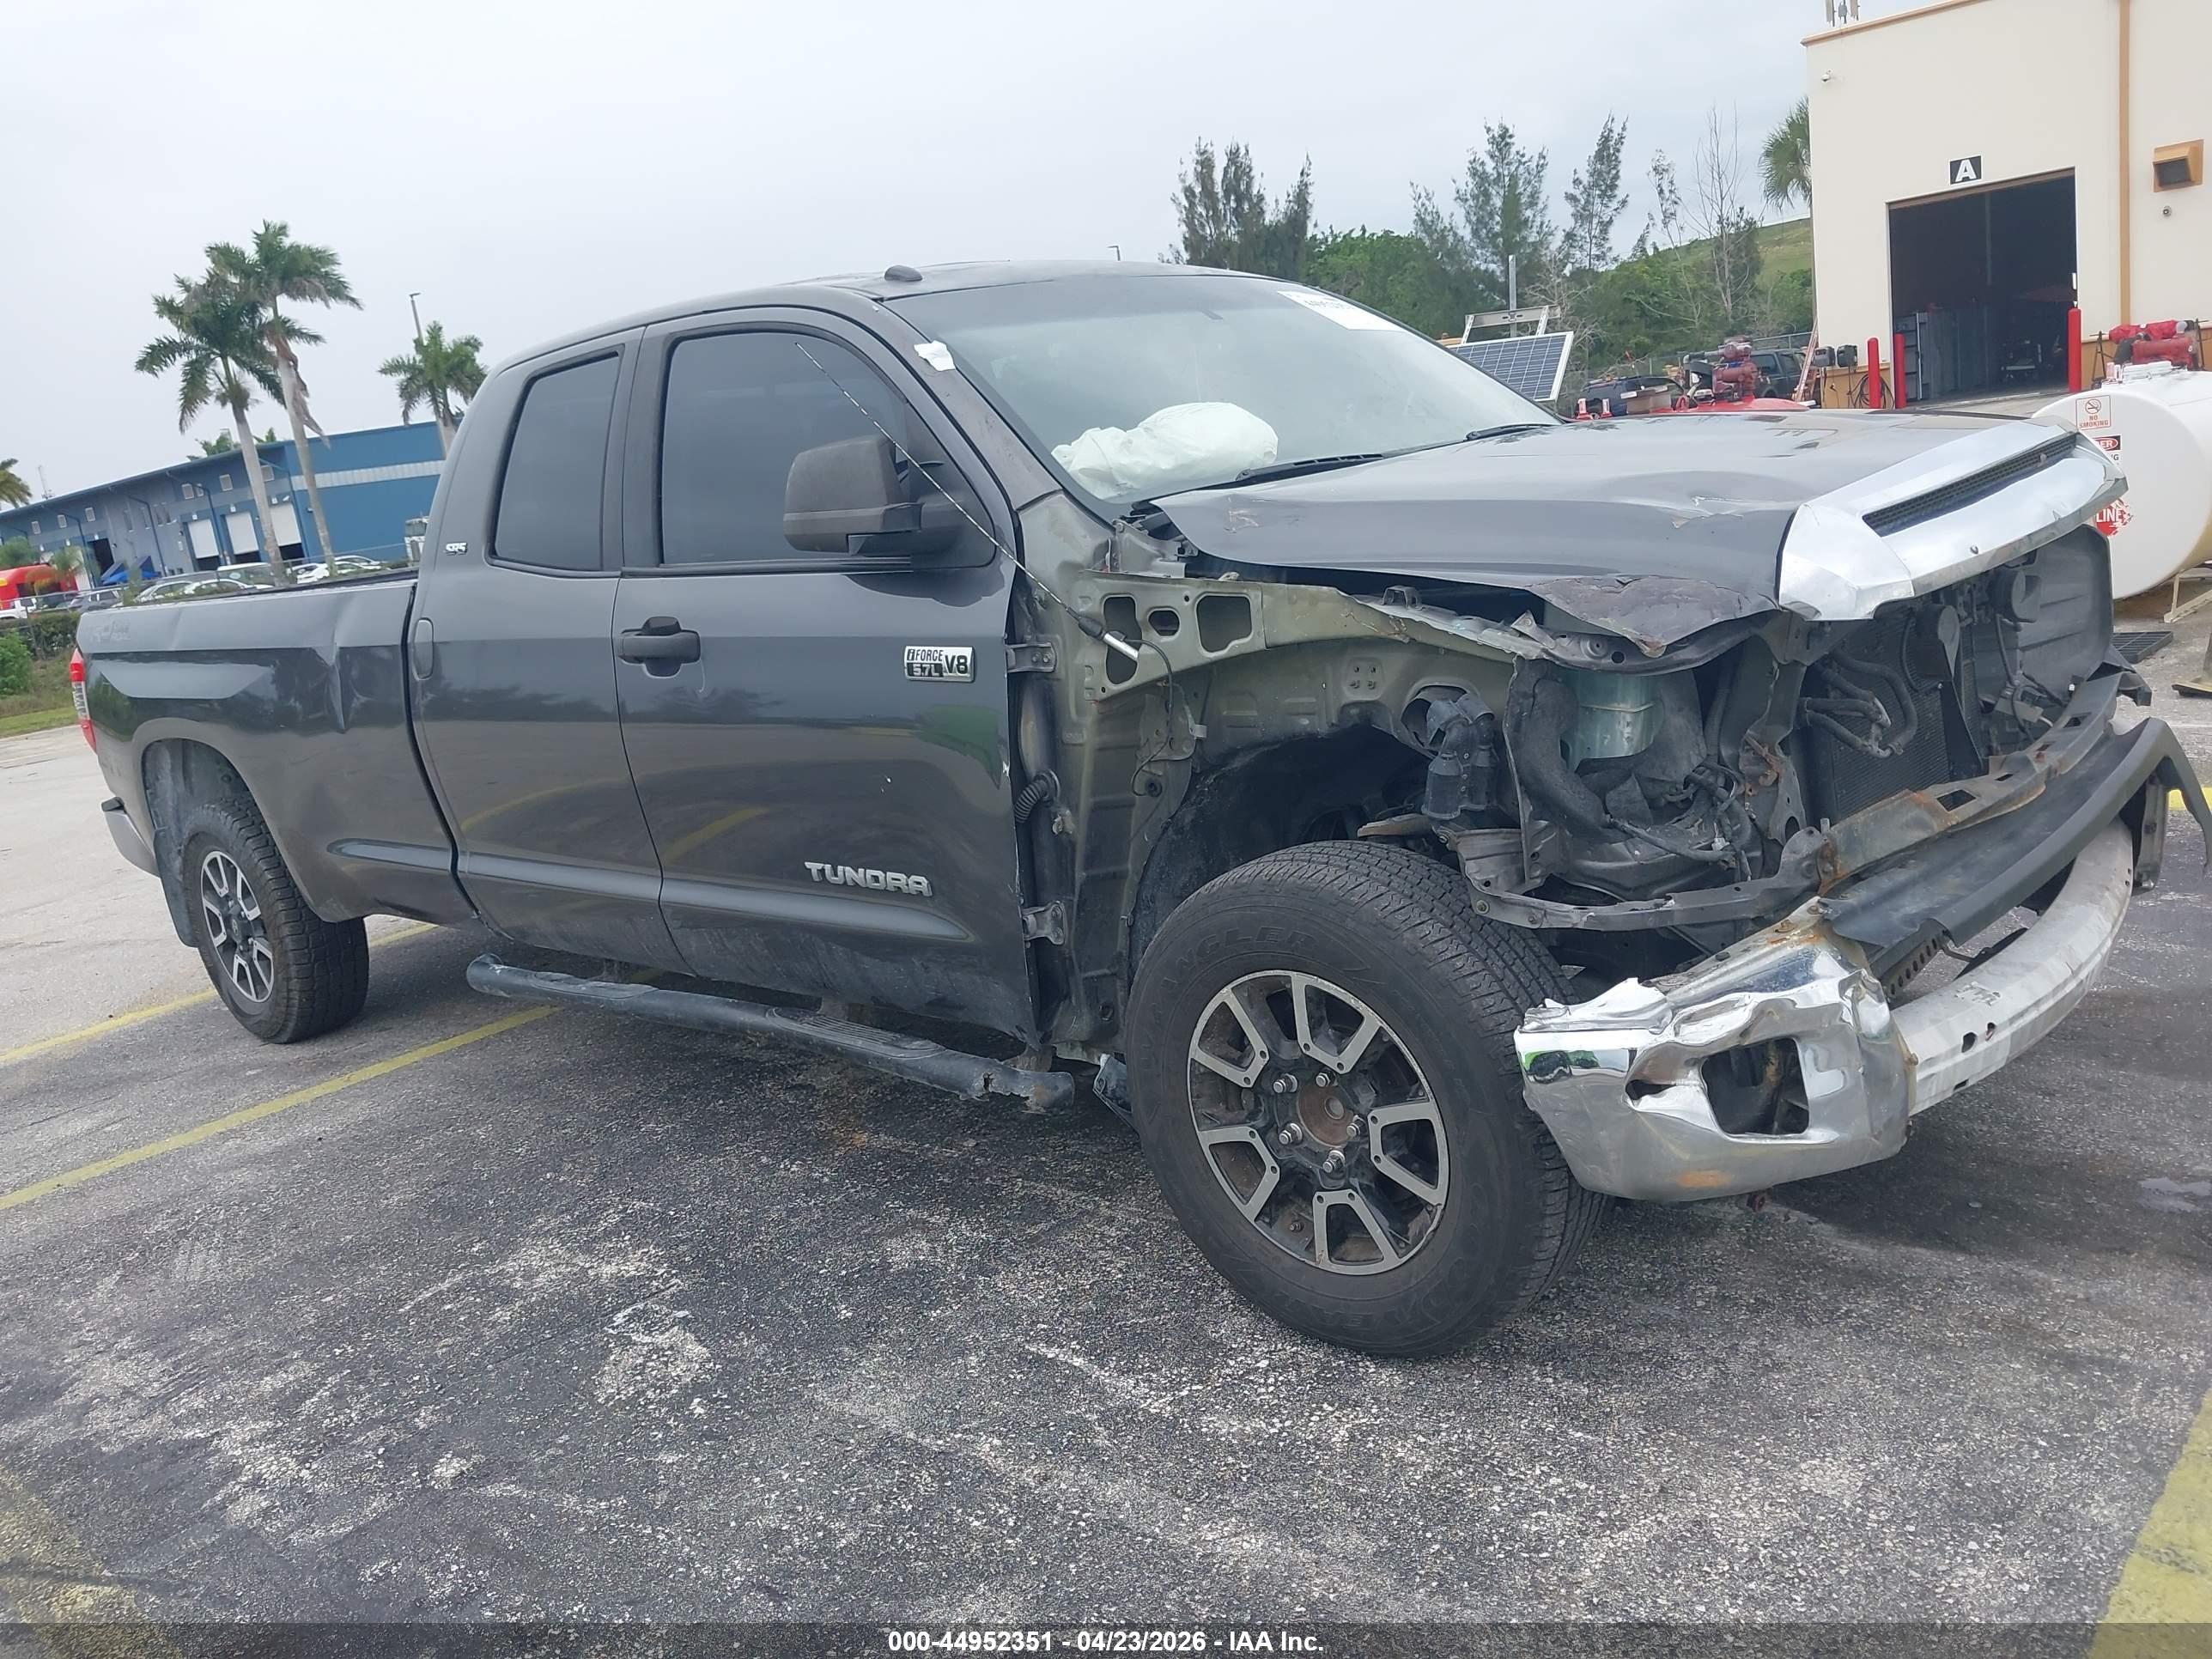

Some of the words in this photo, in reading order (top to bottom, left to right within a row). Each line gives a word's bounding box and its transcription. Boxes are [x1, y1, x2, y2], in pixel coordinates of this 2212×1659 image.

[1955, 159, 1977, 182] A
[913, 663, 940, 677] 5.7L
[945, 654, 969, 675] V8
[804, 861, 933, 897] TUNDRA
